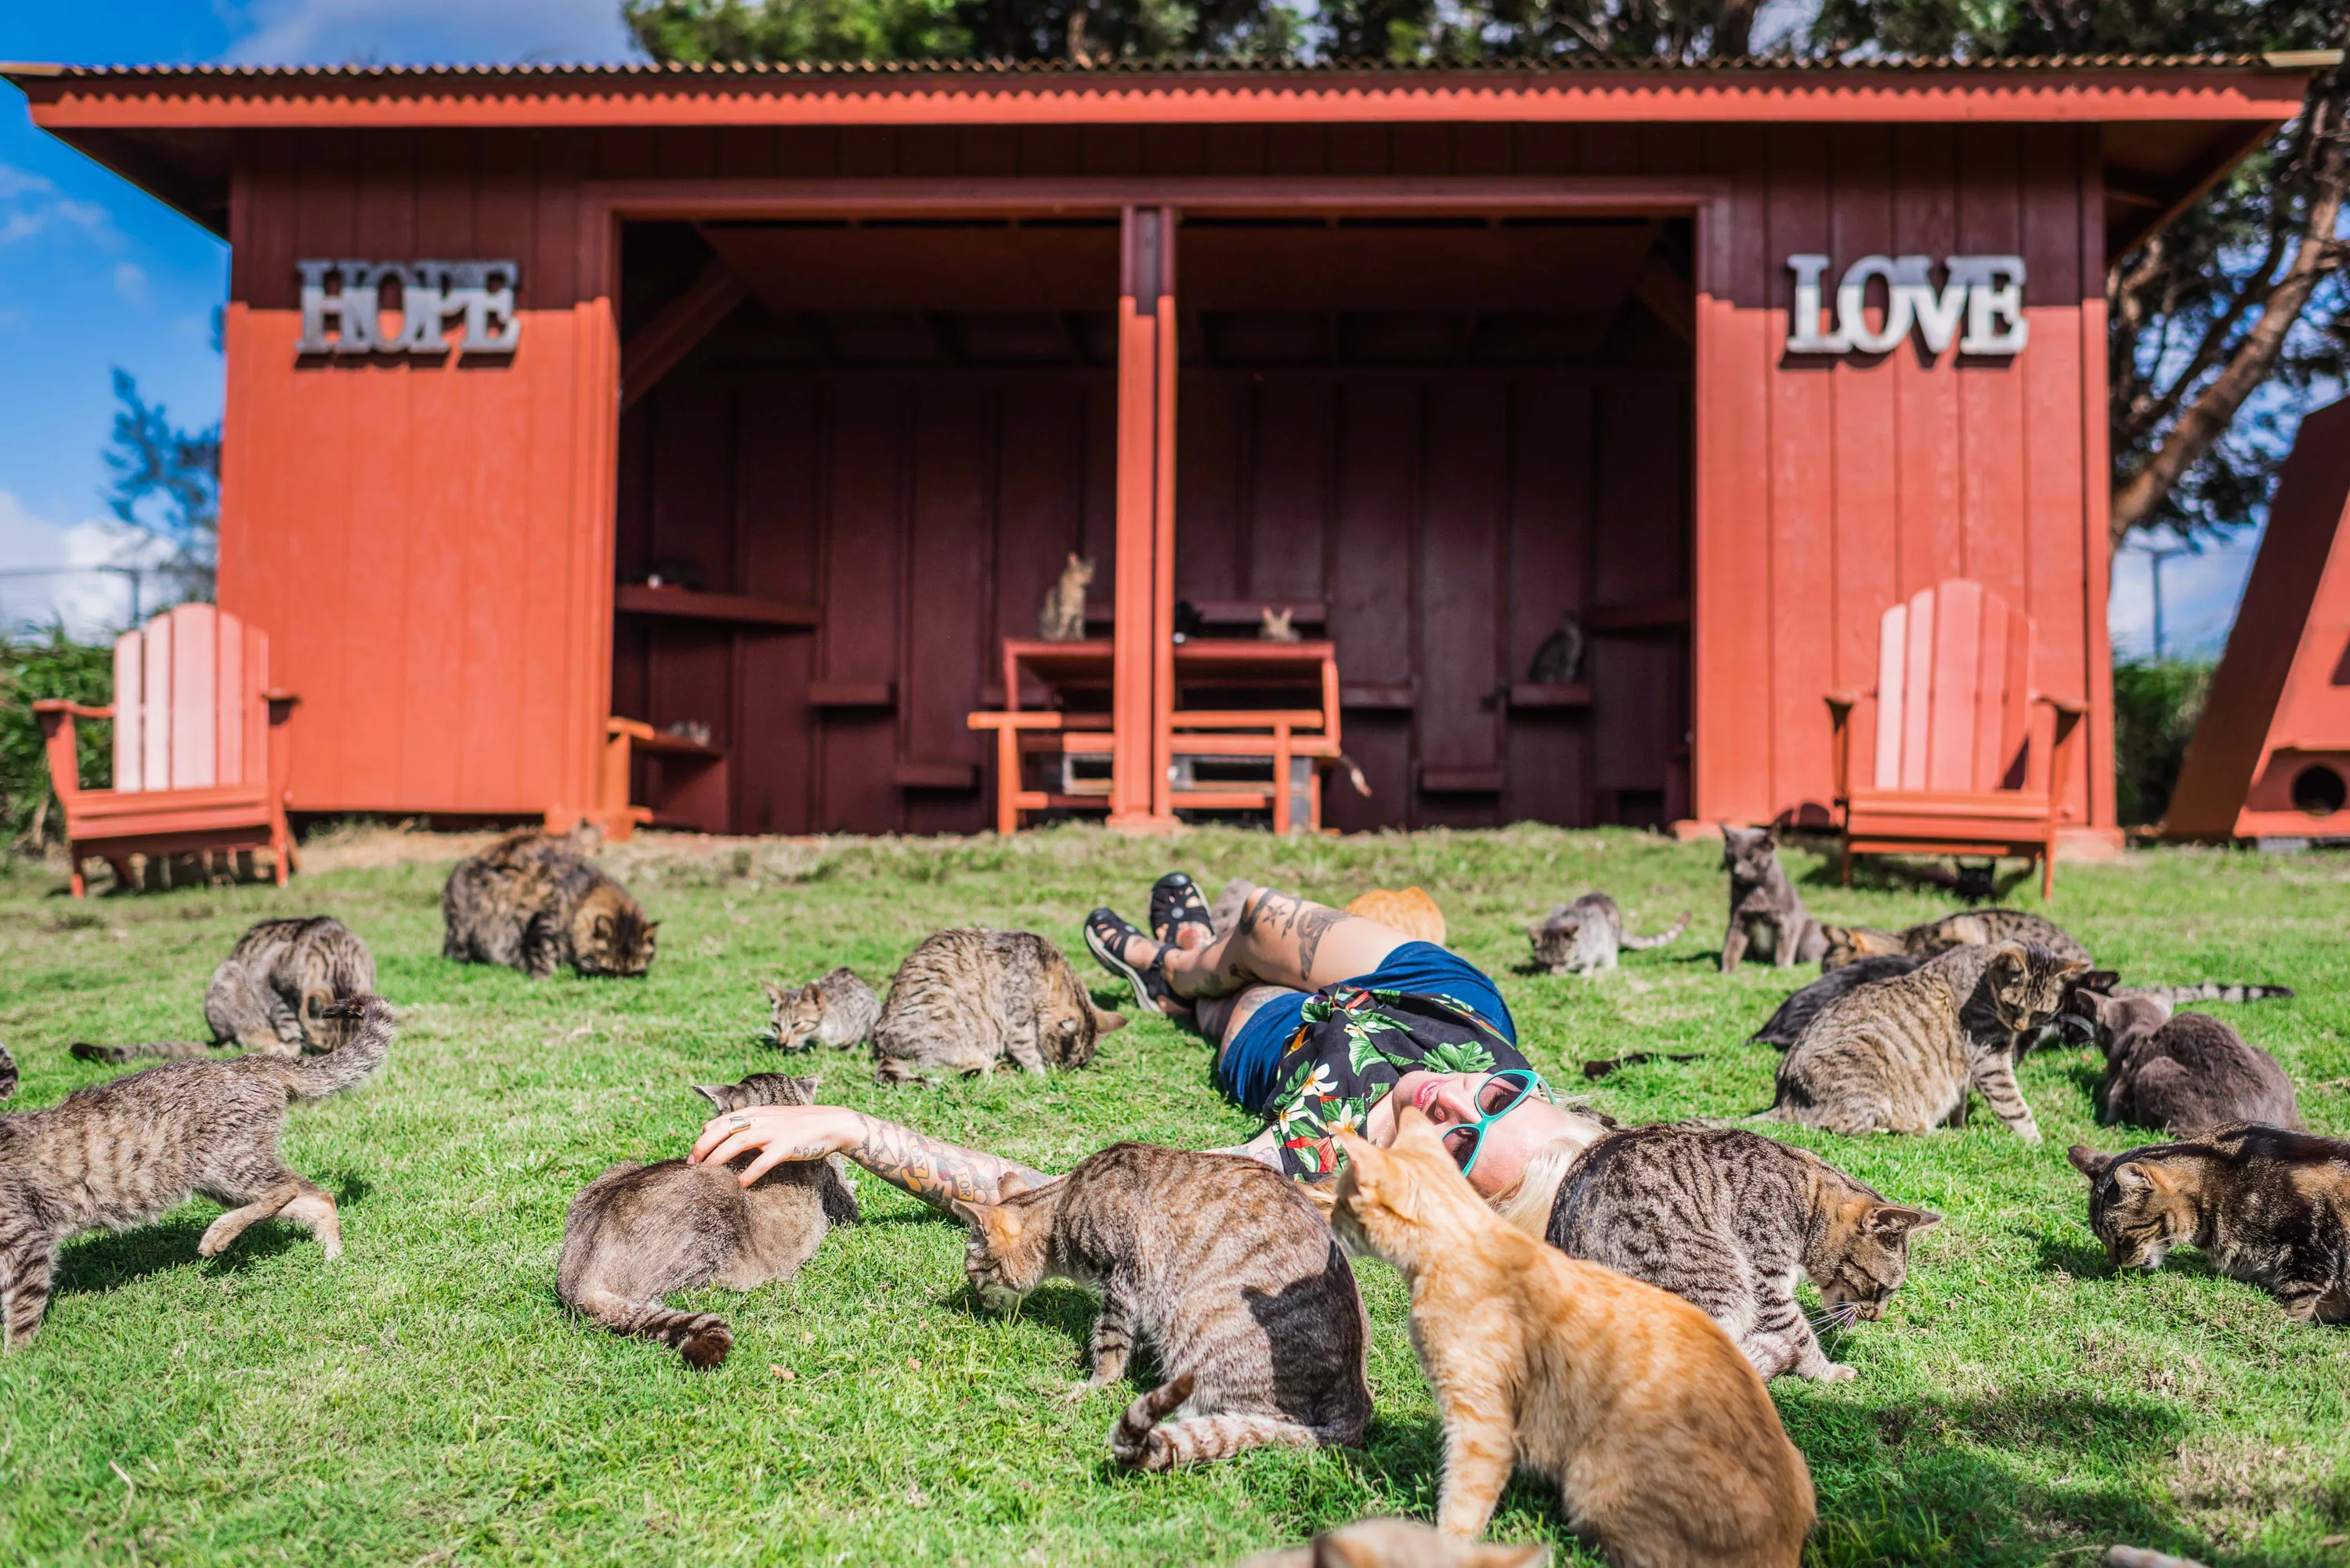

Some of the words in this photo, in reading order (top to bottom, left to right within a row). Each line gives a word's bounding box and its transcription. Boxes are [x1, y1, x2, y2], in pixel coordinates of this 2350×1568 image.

[295, 259, 520, 354] HOPE
[1787, 255, 2027, 355] LOVE
[910, 1144, 926, 1170] DAY
[958, 1172, 971, 1197] FOR
